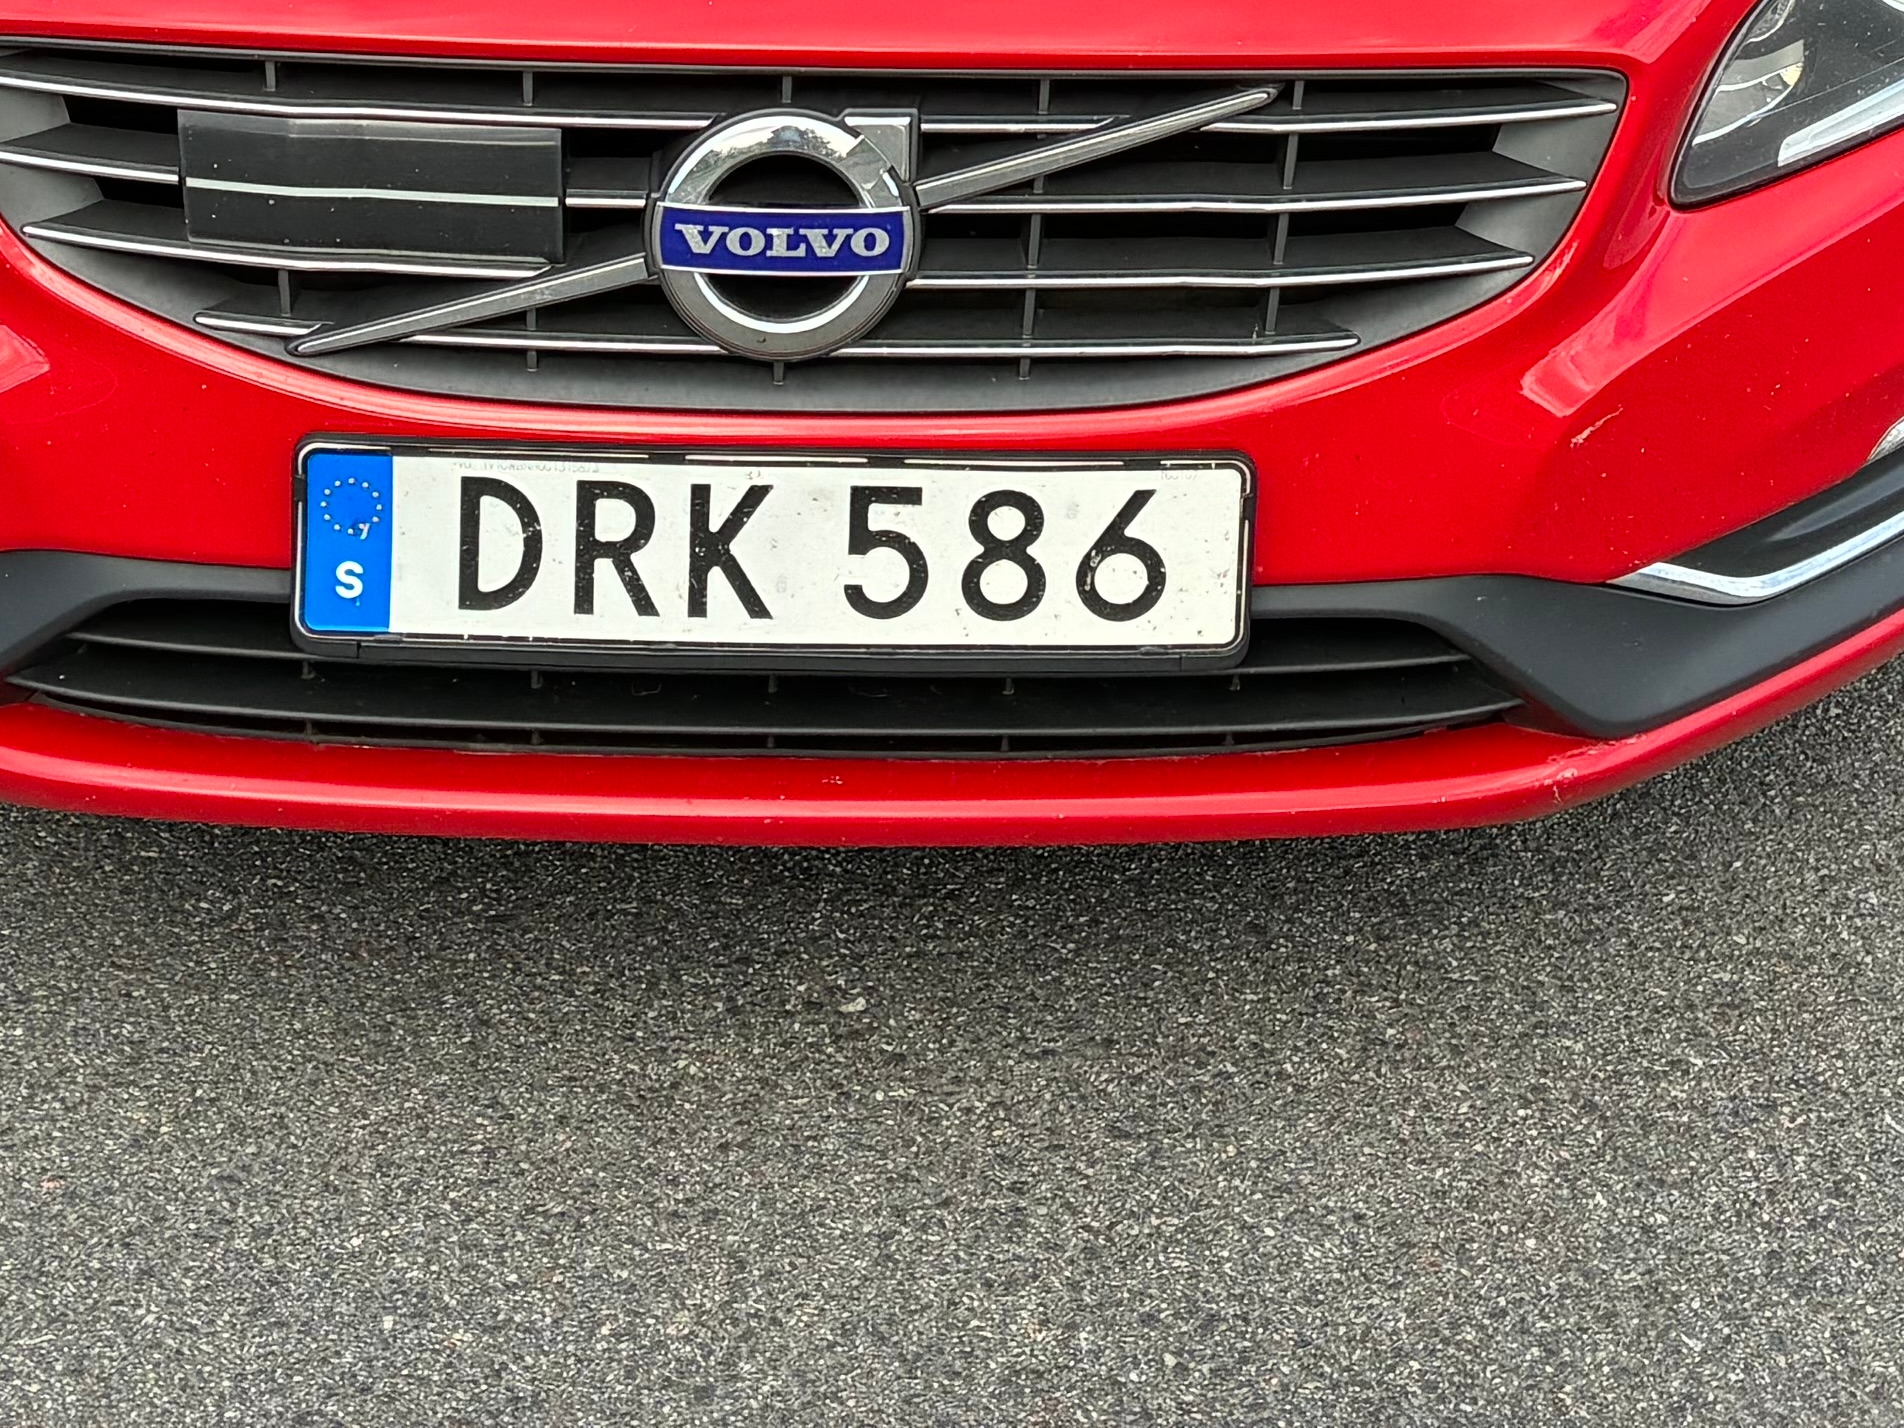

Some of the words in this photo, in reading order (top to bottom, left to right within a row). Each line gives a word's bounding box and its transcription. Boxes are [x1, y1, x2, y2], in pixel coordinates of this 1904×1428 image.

[674, 223, 890, 258] VOLVO
[458, 476, 773, 621] DRK
[843, 485, 1168, 622] 586
[335, 560, 364, 599] S
